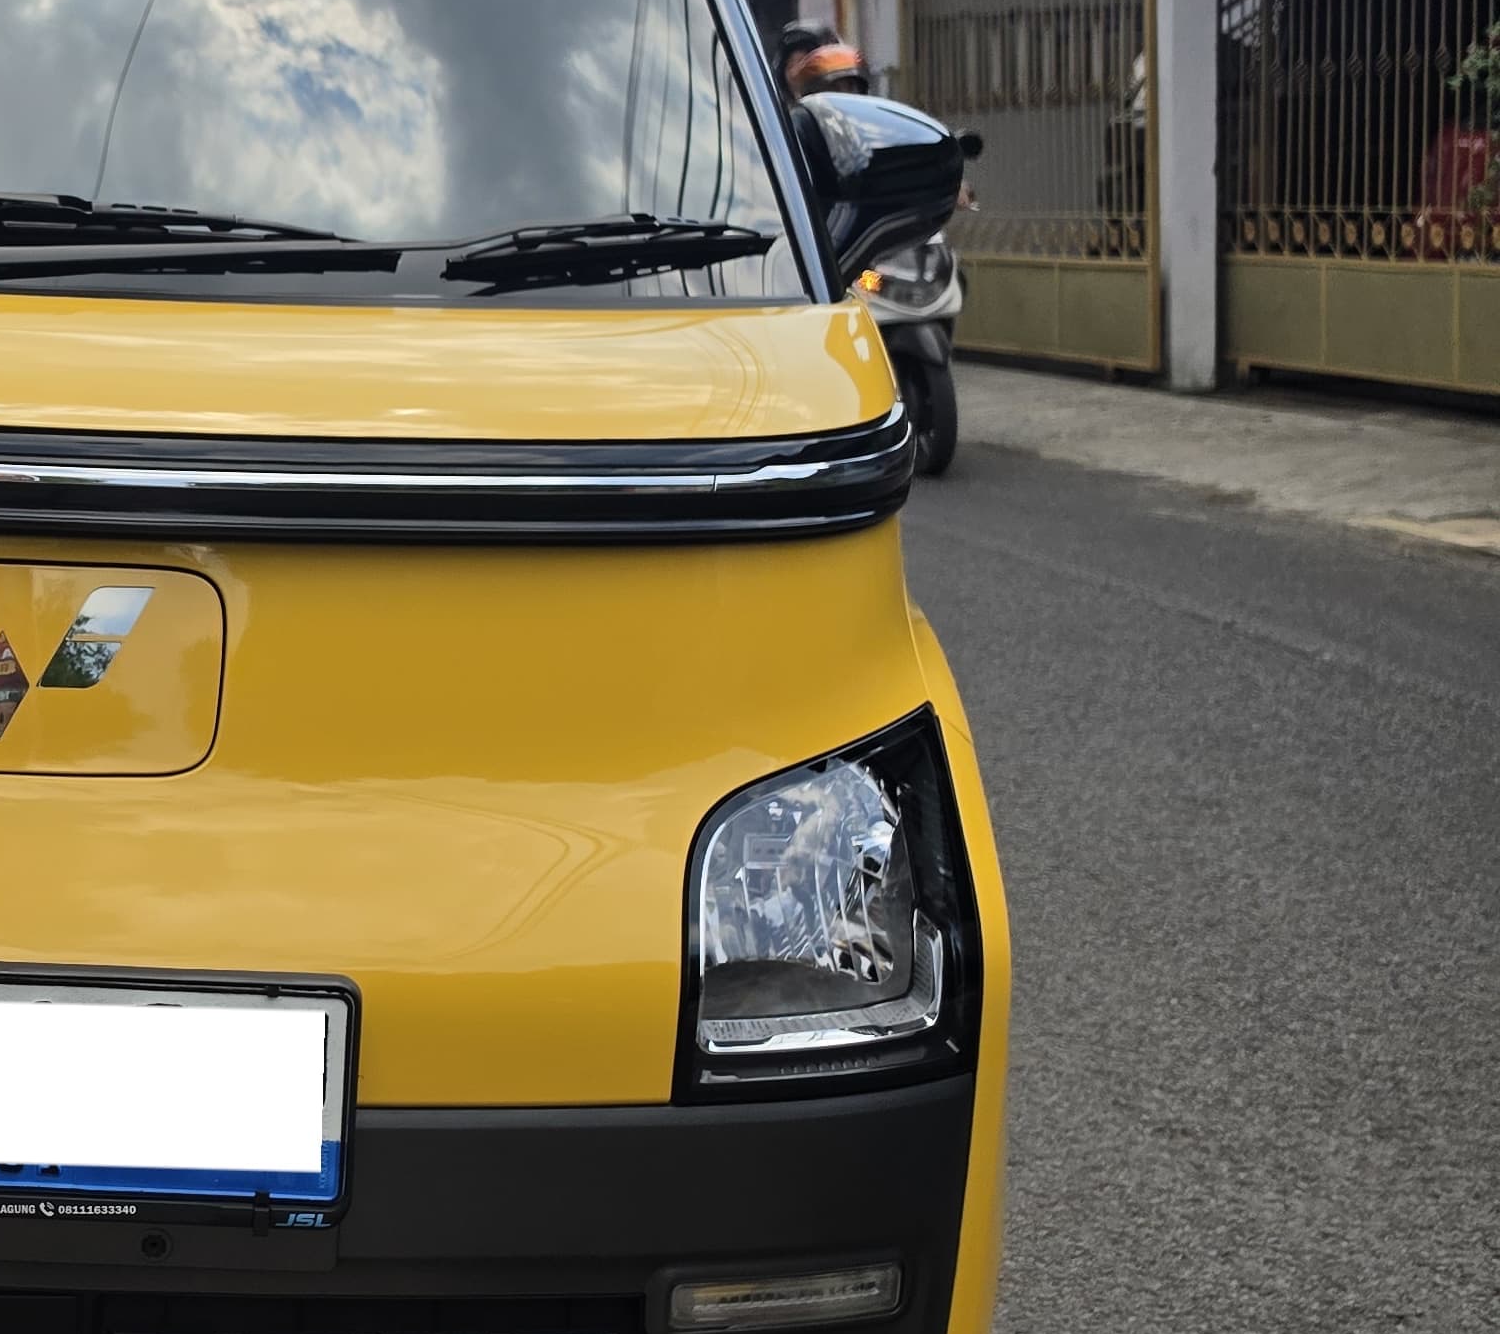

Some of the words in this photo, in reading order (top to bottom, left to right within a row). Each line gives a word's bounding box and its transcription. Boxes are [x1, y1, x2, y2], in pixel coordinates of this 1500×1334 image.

[0, 1203, 36, 1215] AGUNG
[58, 1204, 137, 1215] 08111633340
[275, 1213, 331, 1227] JSL
